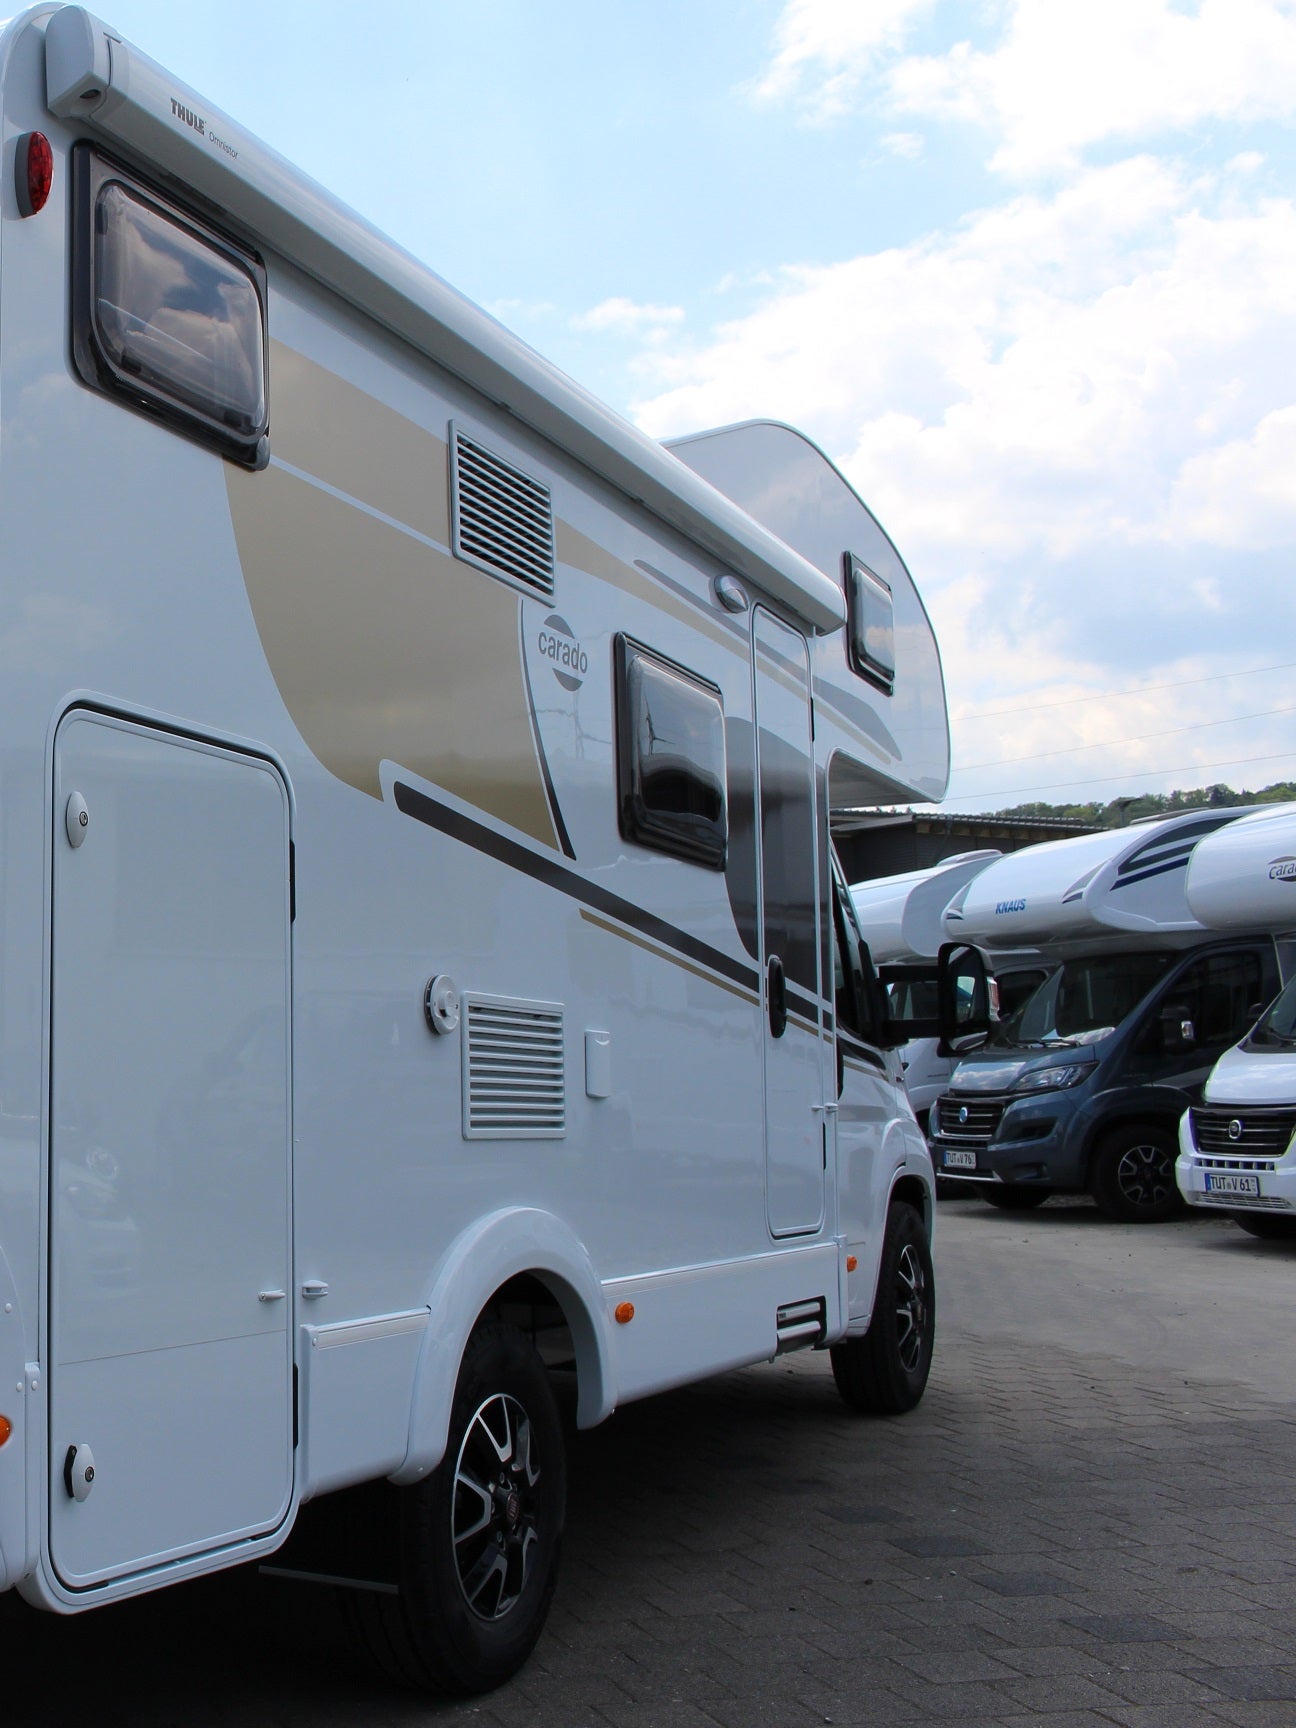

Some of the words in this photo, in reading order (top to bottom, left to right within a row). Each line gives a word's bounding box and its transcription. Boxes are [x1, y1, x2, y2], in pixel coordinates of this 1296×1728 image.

[170, 97, 205, 136] THULE
[208, 131, 239, 160] Omnistor
[538, 631, 588, 674] carado
[1268, 862, 1296, 880] cara
[995, 898, 1027, 915] KNAUS
[1210, 1176, 1226, 1190] TUT
